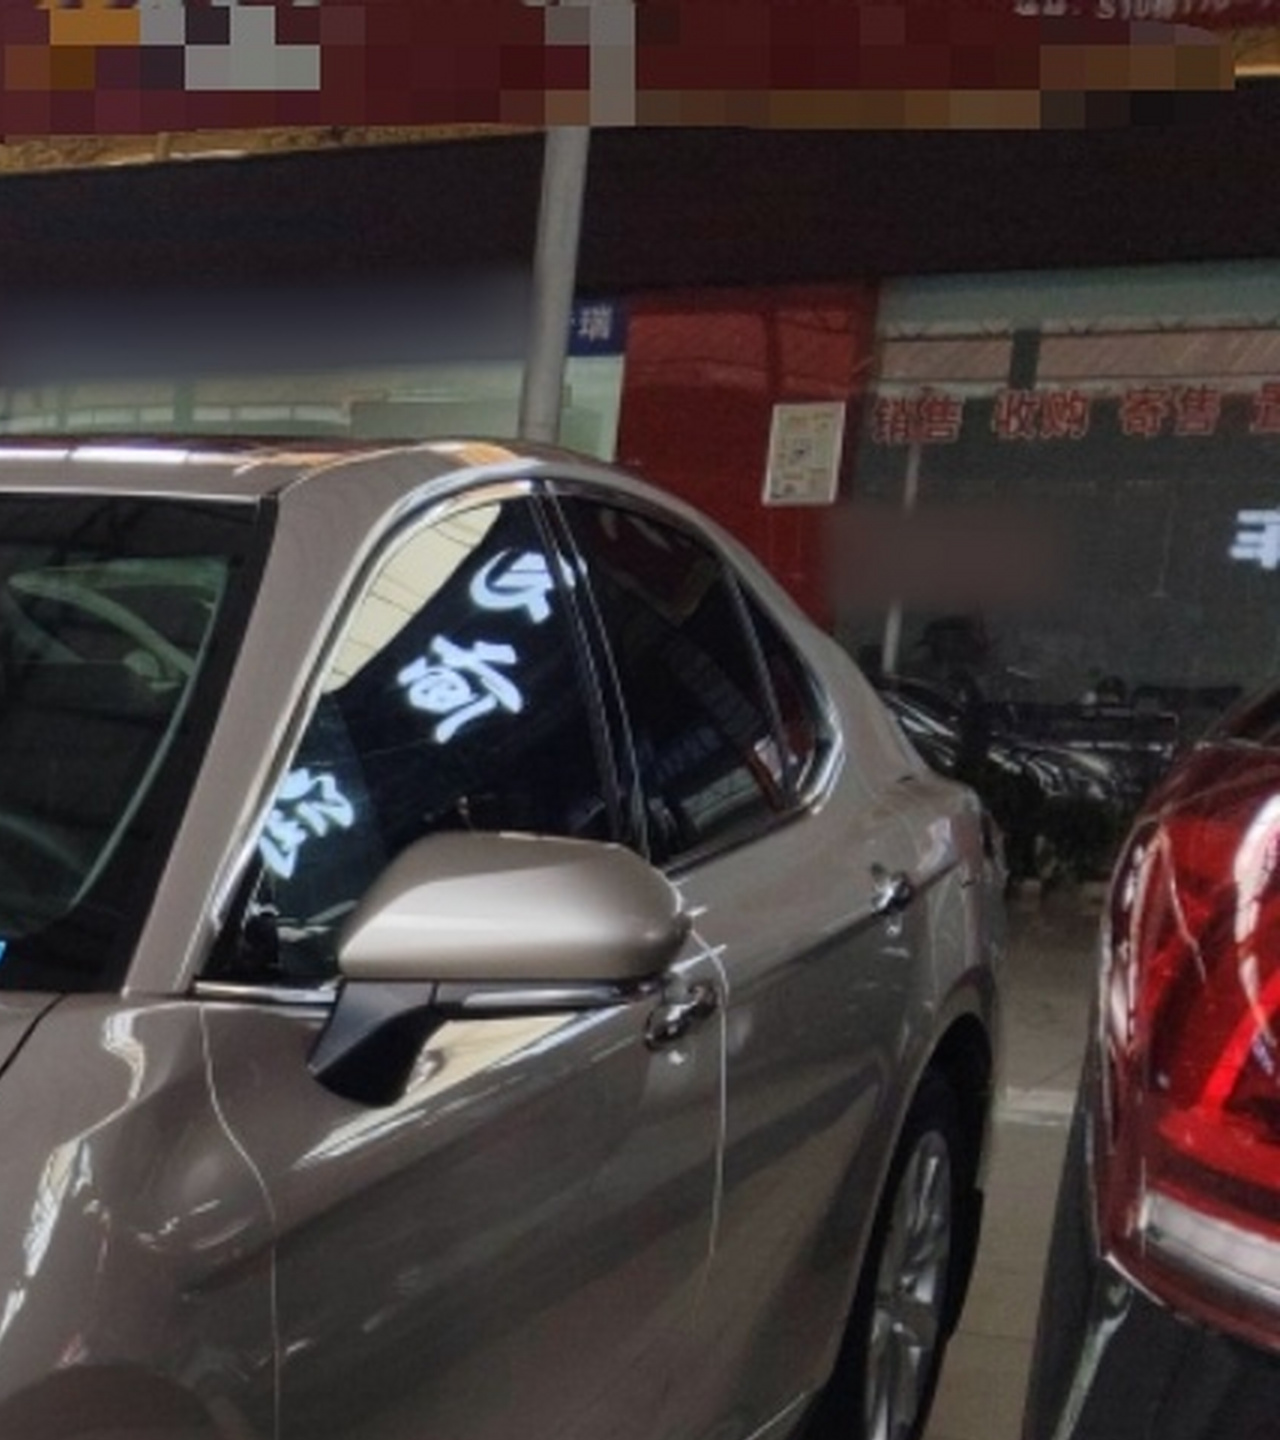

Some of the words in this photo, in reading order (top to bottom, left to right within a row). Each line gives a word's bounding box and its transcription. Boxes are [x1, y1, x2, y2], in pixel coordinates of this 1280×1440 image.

[872, 385, 962, 443] 销售
[992, 388, 1089, 439] 收购
[1119, 382, 1221, 436] 寄售
